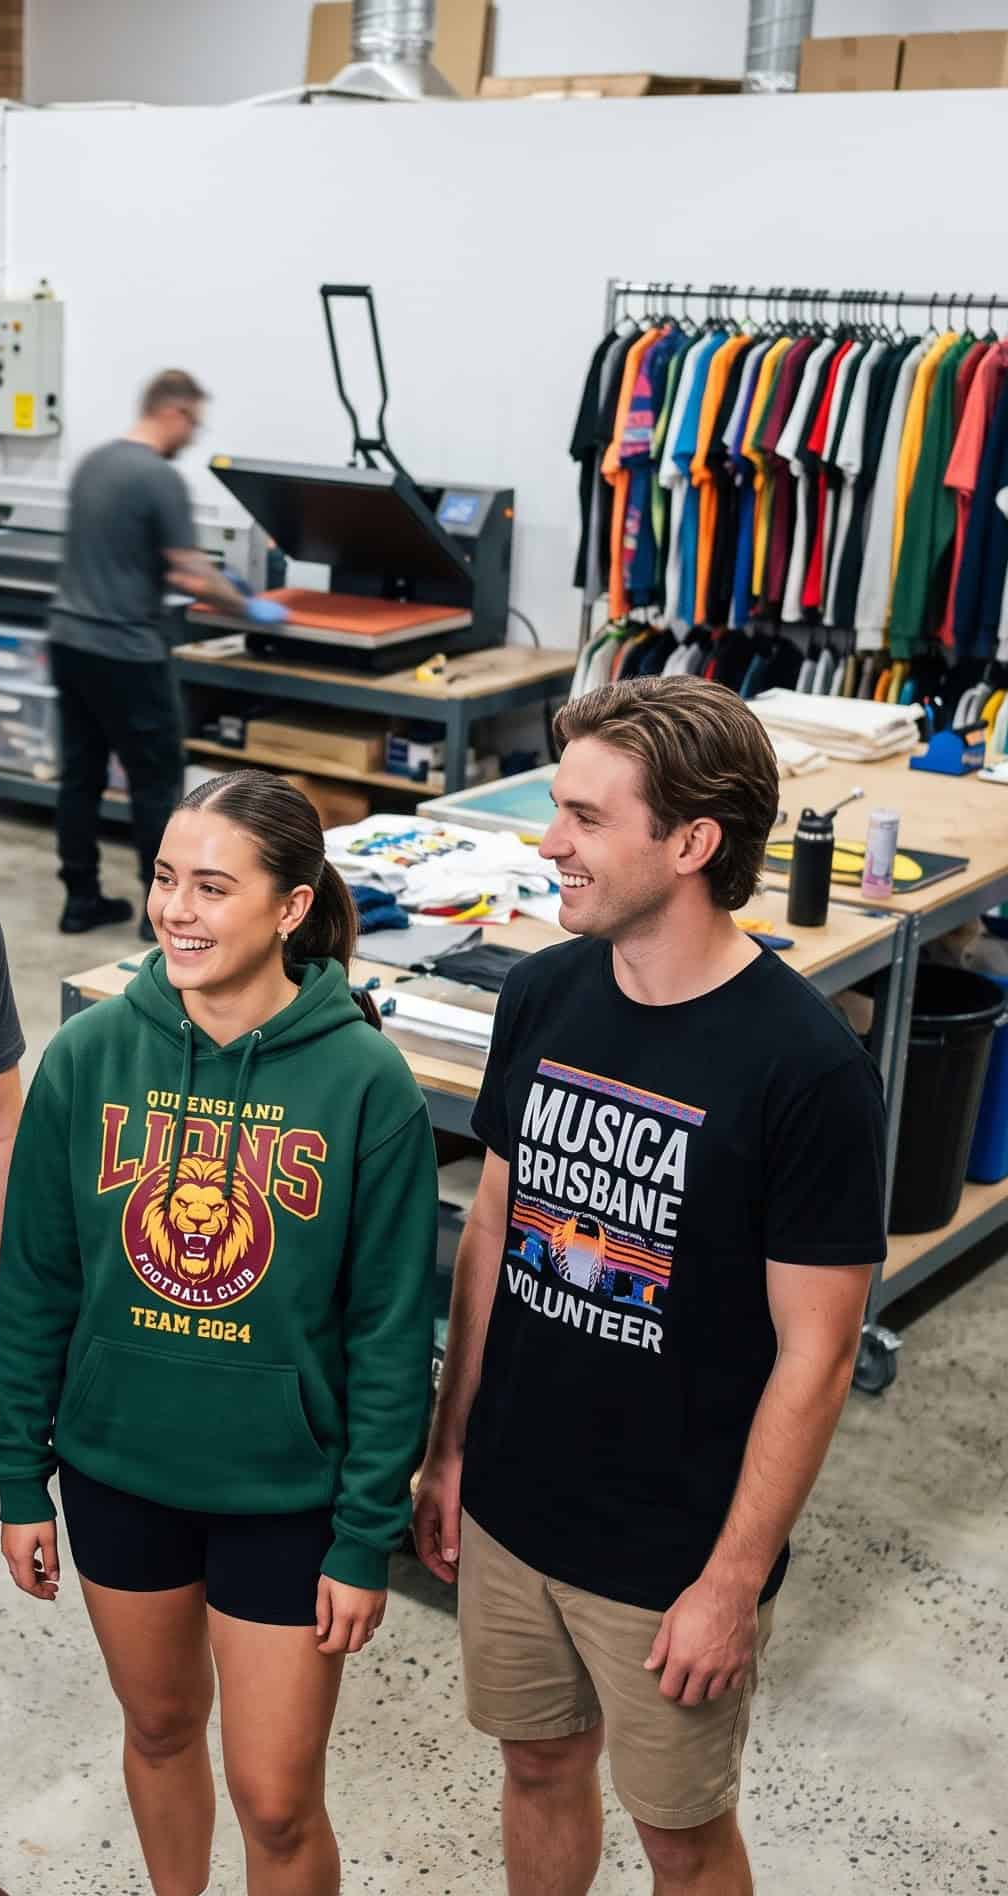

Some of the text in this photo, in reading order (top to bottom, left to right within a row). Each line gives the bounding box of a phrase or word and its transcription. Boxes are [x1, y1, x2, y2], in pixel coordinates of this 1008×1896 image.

[520, 1082, 689, 1192] MUSICA
[518, 1142, 683, 1238] BRISBANE
[135, 1252, 256, 1303] FOOTBALL CLUB
[506, 1263, 664, 1354] VOLUNTEER
[130, 1306, 252, 1344] TEAM 2024
